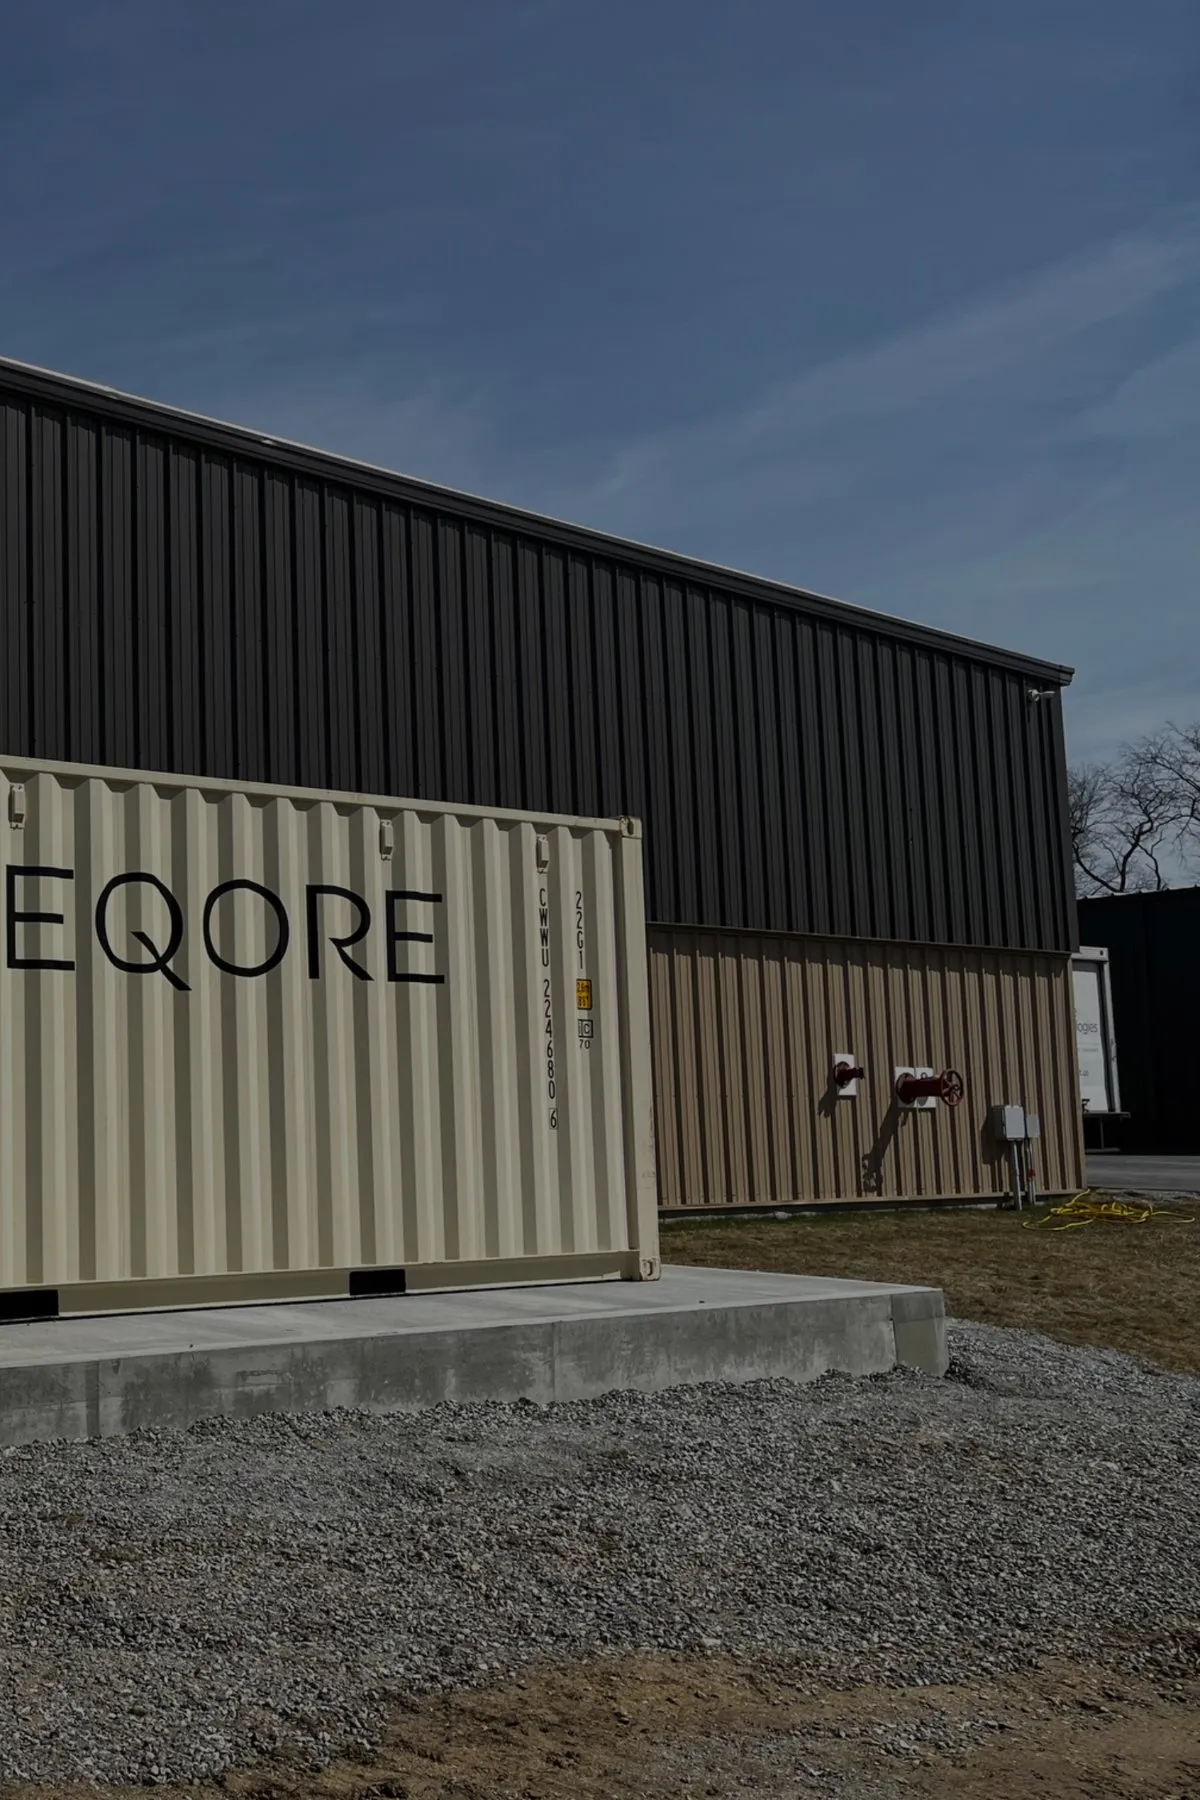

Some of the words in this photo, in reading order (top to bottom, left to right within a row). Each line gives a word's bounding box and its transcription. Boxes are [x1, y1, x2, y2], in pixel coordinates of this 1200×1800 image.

[6, 864, 445, 991] EQORE
[538, 887, 549, 967] CWWU
[575, 891, 584, 969] 22G1
[543, 979, 556, 1100] 224680
[579, 1039, 591, 1049] 70
[550, 1109, 558, 1129] 6
